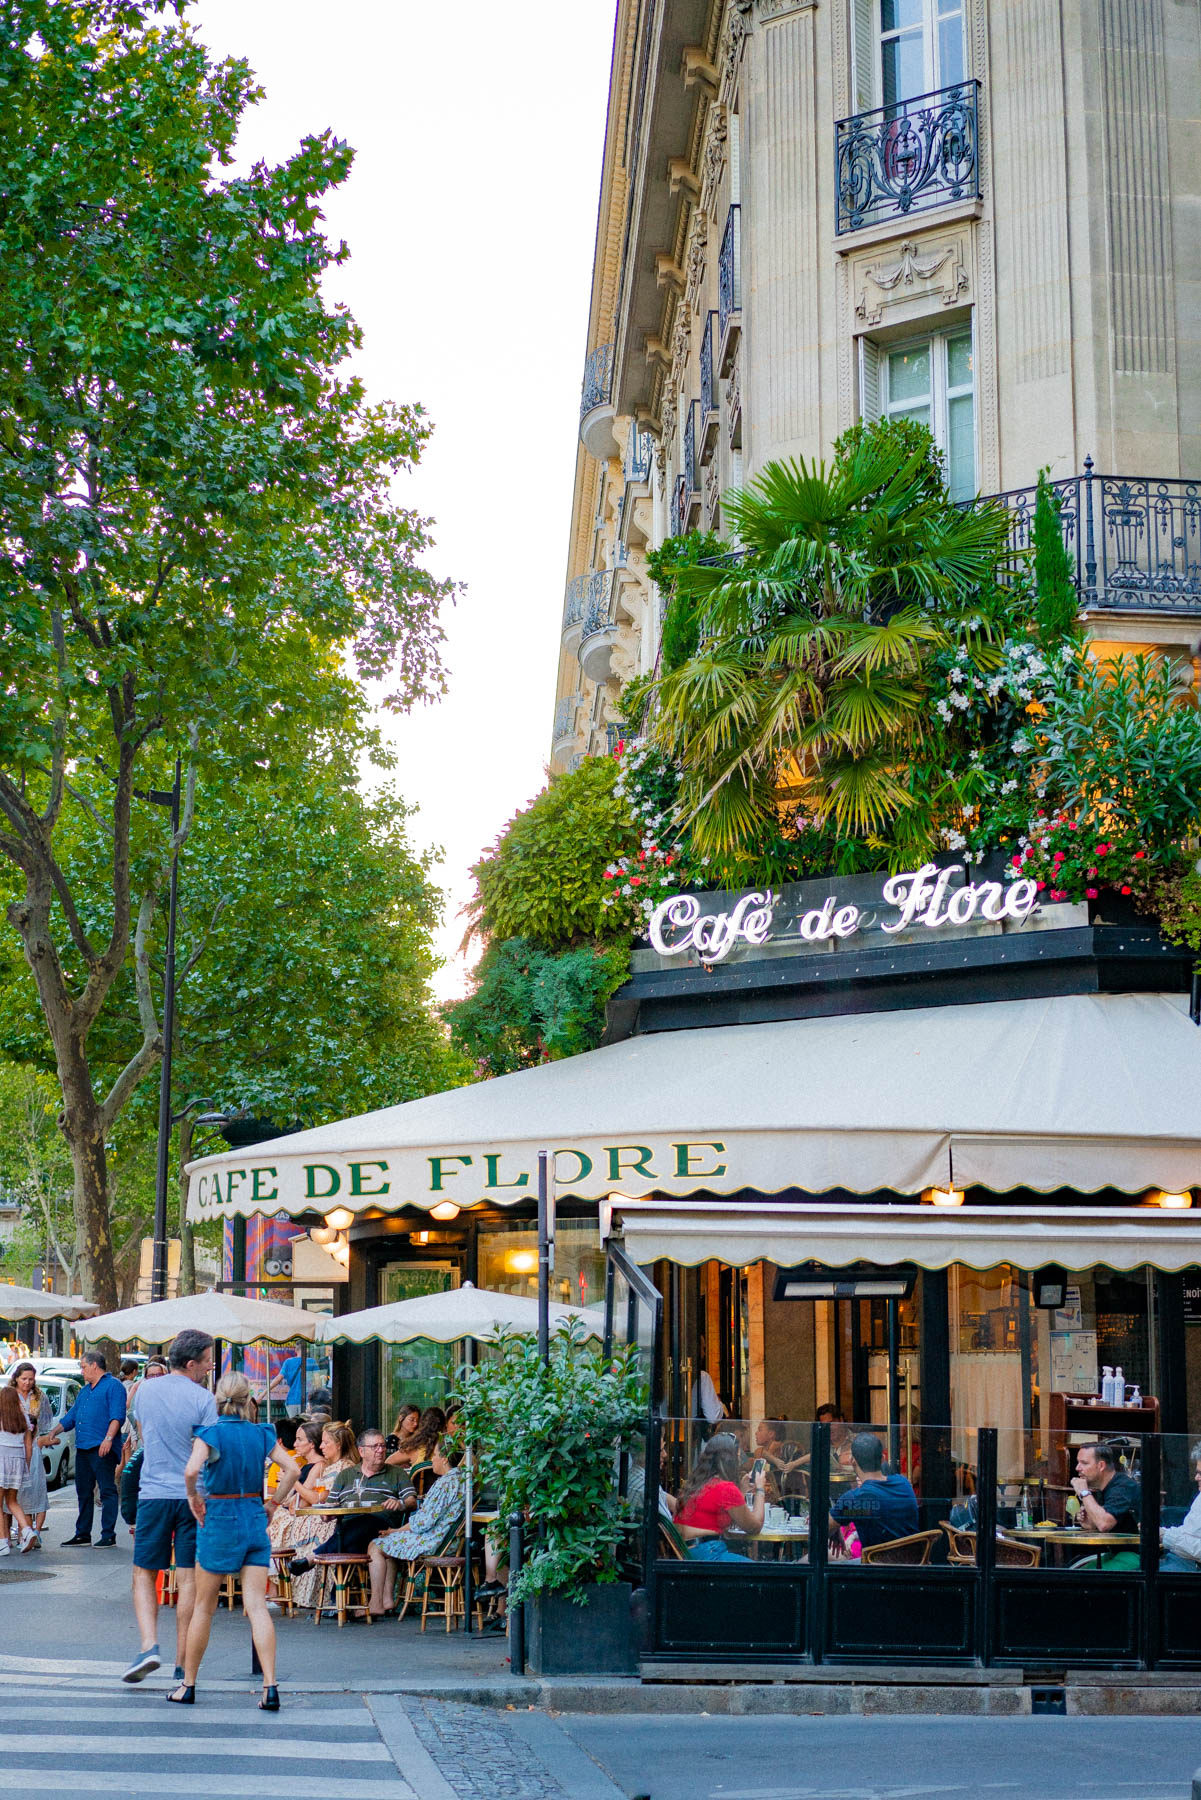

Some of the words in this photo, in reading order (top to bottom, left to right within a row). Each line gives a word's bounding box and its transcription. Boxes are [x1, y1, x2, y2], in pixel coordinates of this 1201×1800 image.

[800, 896, 860, 941] de
[881, 863, 1039, 934] Flore
[198, 1166, 279, 1207] CAFE
[303, 1160, 391, 1198] DE
[428, 1142, 728, 1191] FLORE
